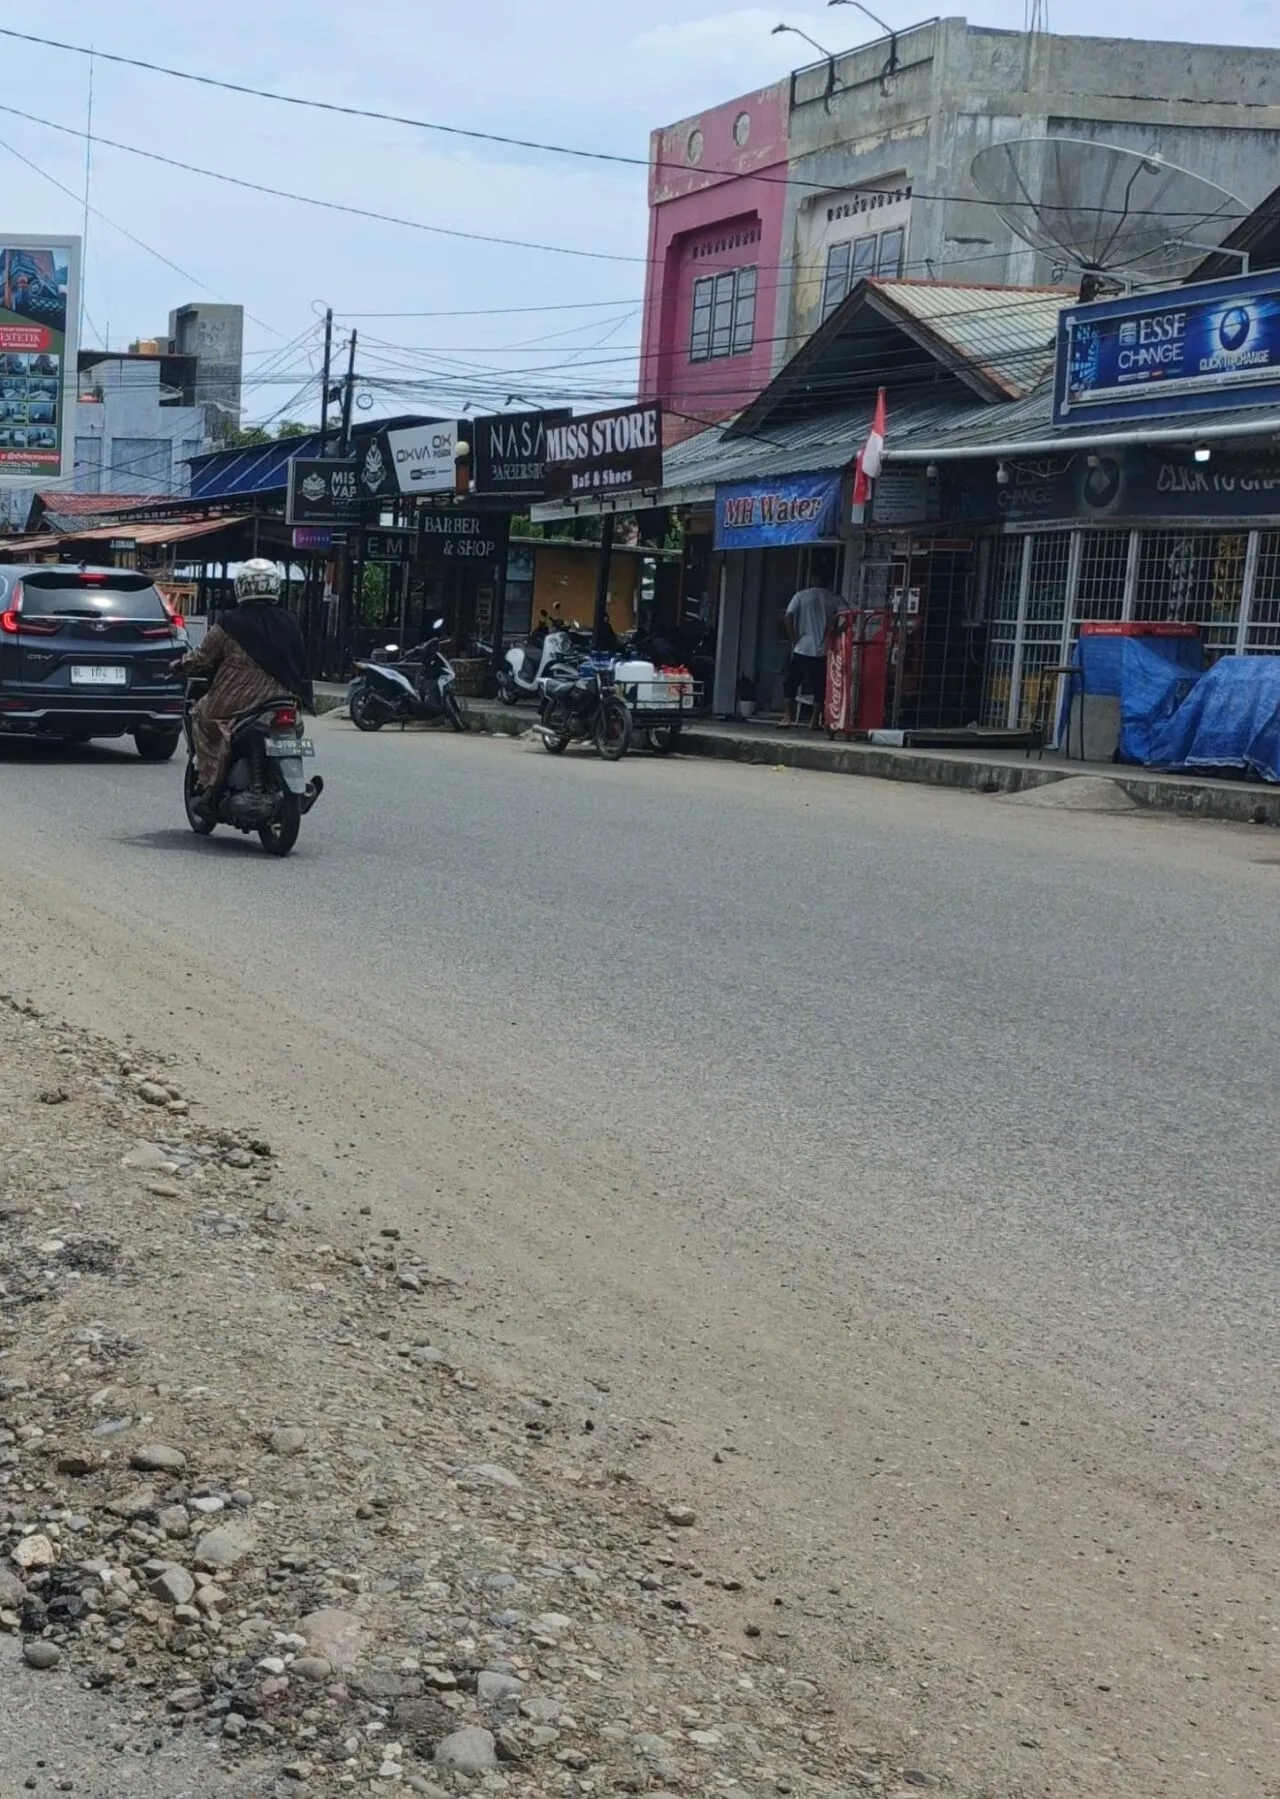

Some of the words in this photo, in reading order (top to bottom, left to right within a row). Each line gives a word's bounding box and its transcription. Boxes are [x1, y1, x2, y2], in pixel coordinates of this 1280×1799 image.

[1140, 313, 1186, 344] ESSE
[1118, 343, 1185, 369] CHANGE
[546, 423, 589, 462] MISS
[592, 410, 657, 455] STORE
[332, 472, 356, 485] MIS
[602, 469, 632, 485] Shoes
[331, 486, 357, 497] VAP
[724, 496, 757, 528] MH
[760, 493, 822, 527] Water
[424, 517, 480, 534] BARBER
[443, 541, 453, 555] &
[457, 541, 495, 556] SHOP
